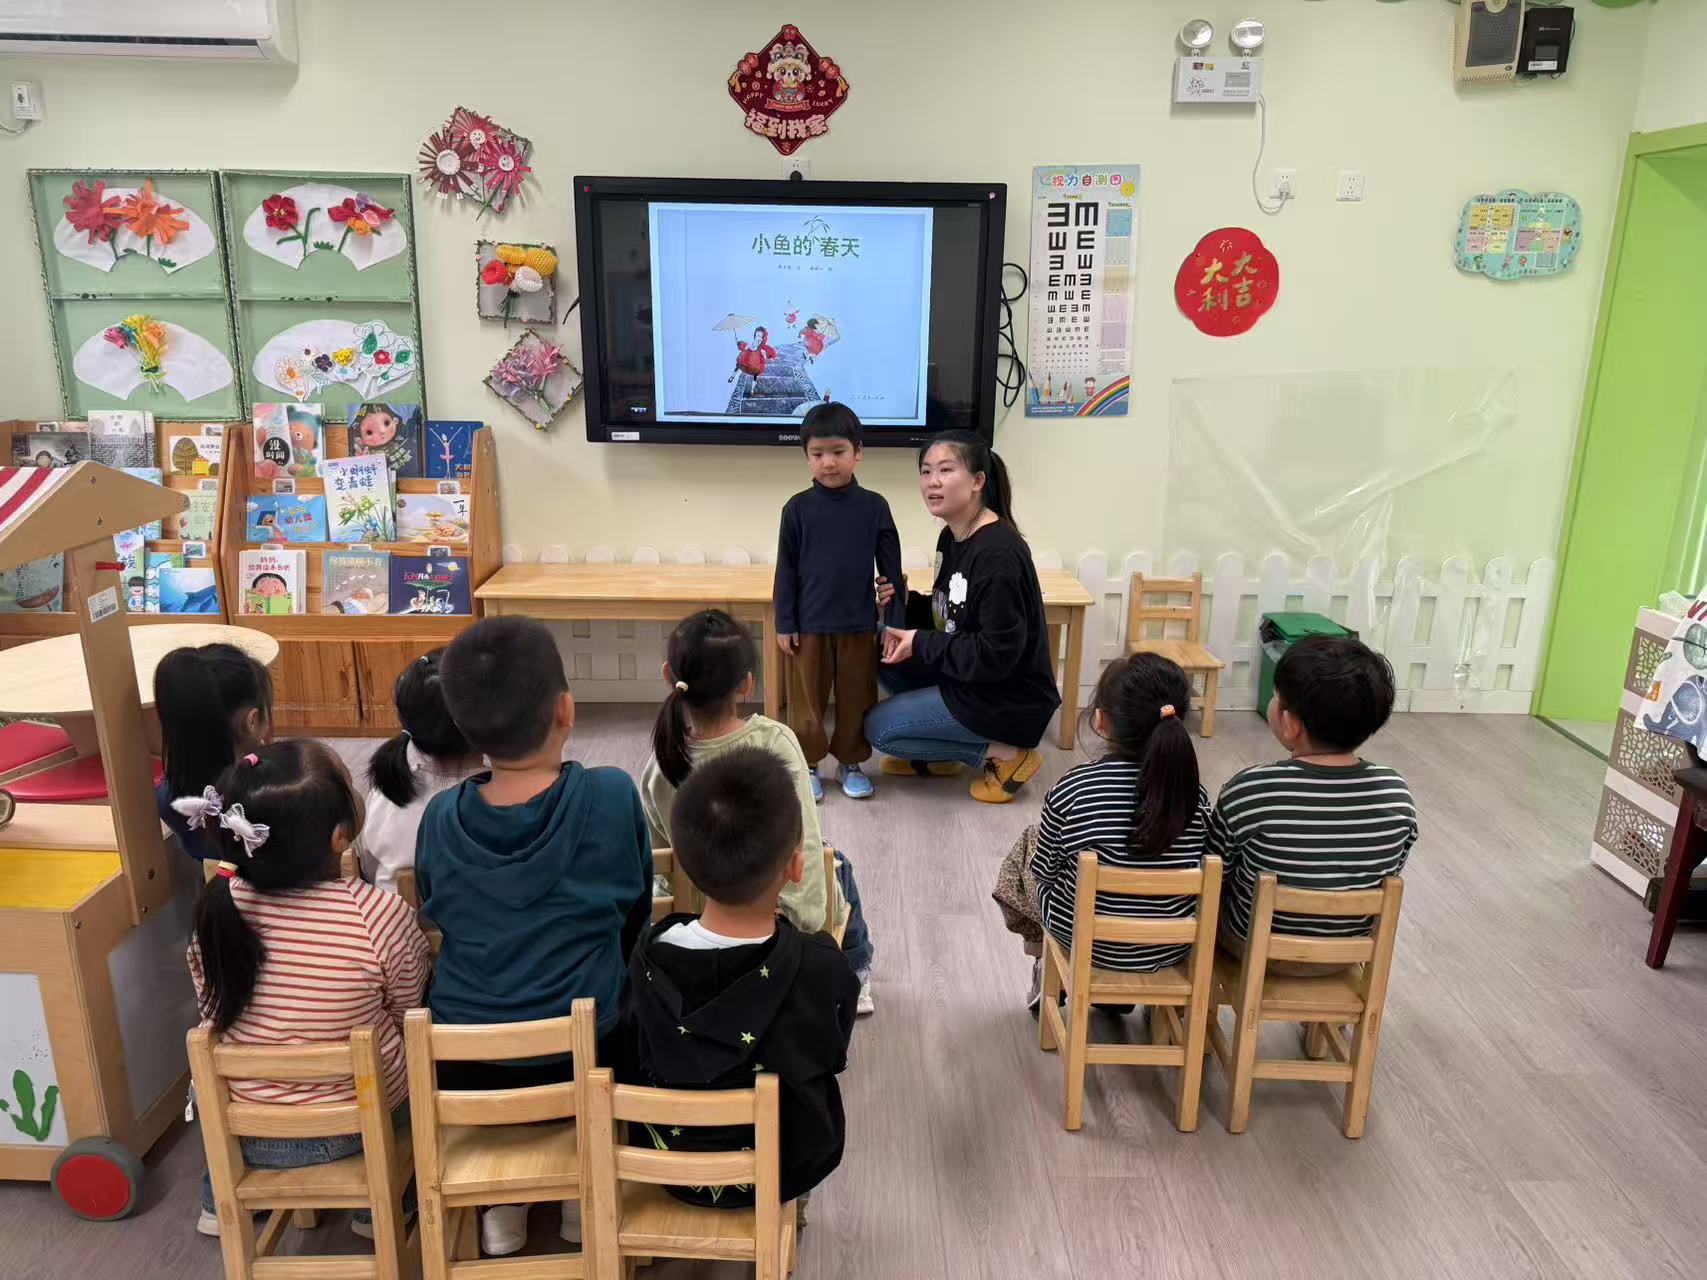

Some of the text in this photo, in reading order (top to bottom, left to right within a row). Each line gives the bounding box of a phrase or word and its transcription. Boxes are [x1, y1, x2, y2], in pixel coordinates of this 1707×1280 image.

[744, 108, 828, 139] 福到我家
[752, 233, 860, 258] 小鱼的春天
